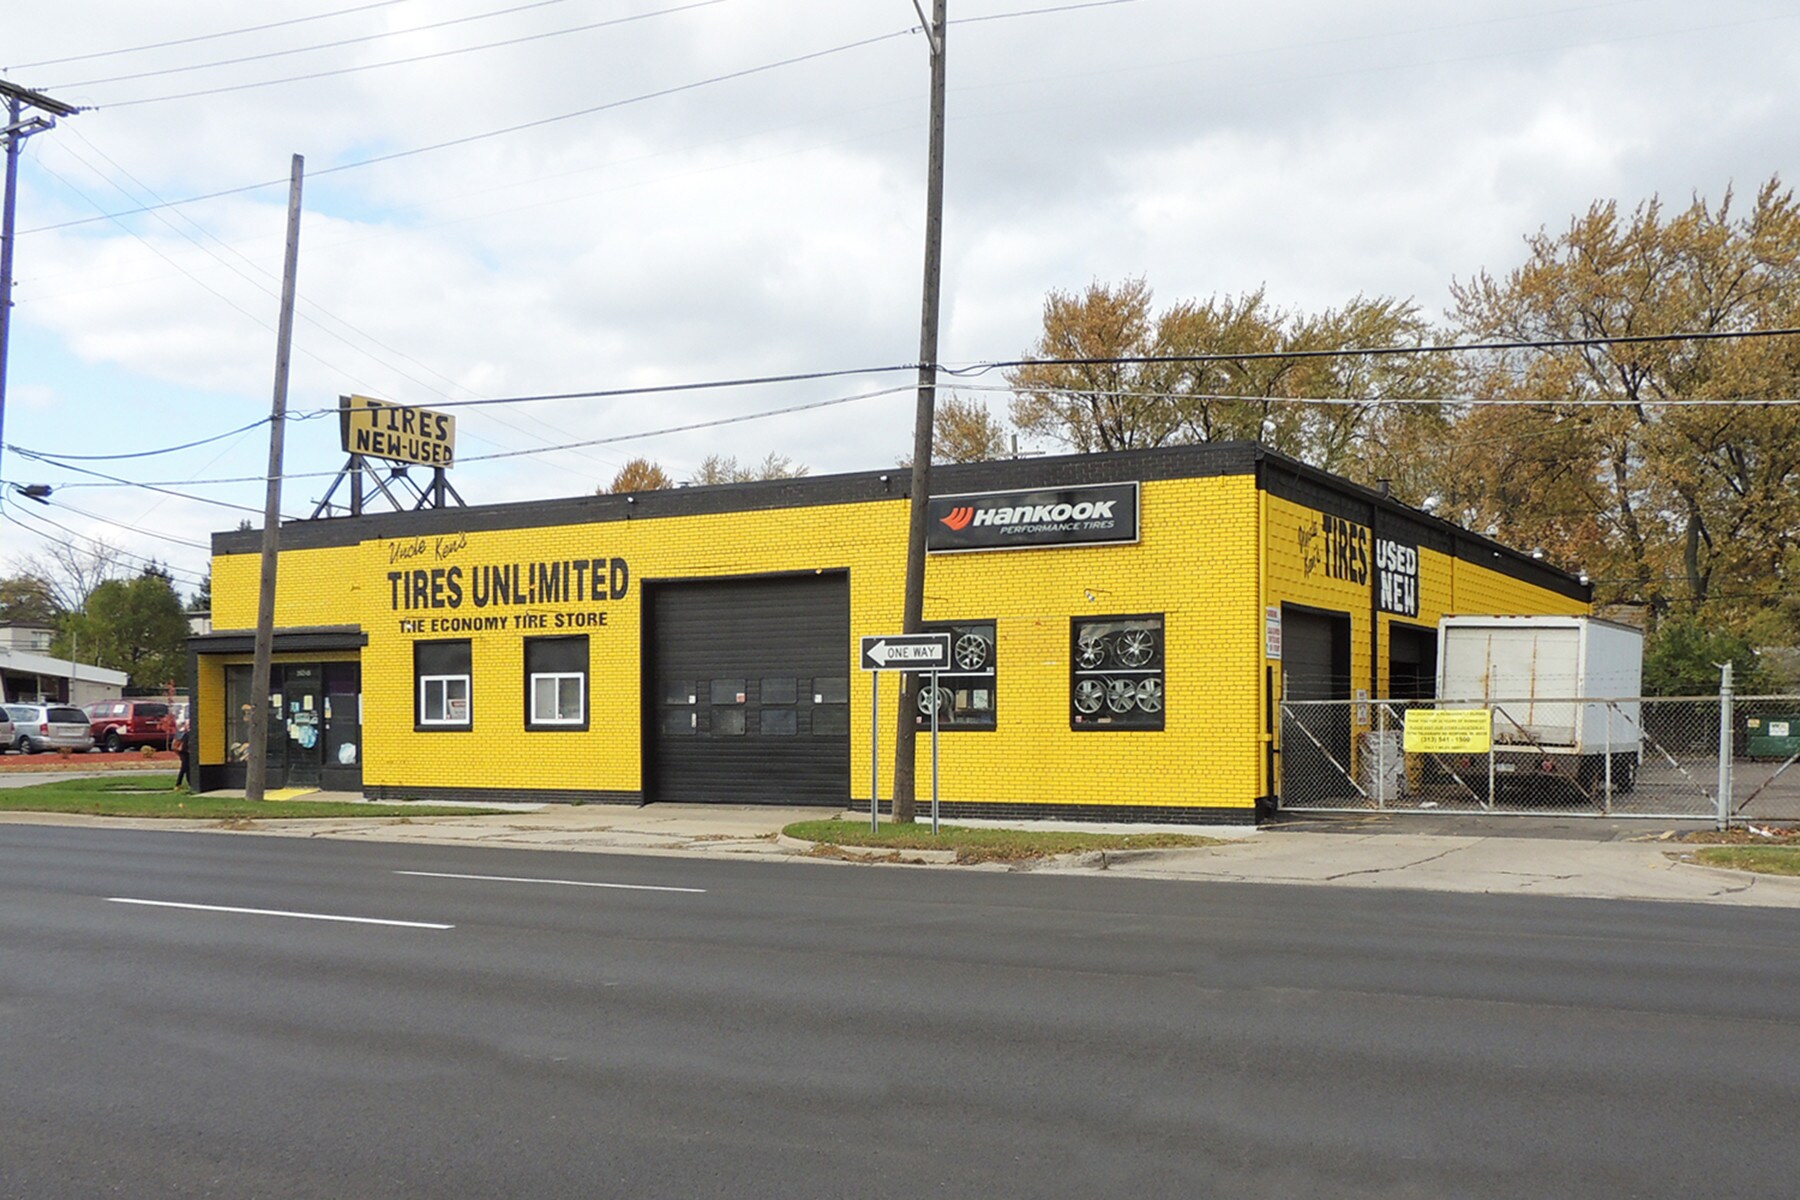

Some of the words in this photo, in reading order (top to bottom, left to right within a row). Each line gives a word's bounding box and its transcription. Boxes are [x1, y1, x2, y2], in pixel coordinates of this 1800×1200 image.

[366, 401, 449, 442] TIRES
[356, 429, 453, 466] NEW-USED
[999, 521, 1080, 535] PERFORMANCE
[1082, 519, 1115, 530] TIRES
[388, 536, 427, 565] Uncle
[1322, 514, 1368, 587] TIRES
[1376, 538, 1417, 577] USED
[387, 565, 463, 610] TIRES
[472, 557, 629, 608] UNLIMITED
[1380, 570, 1415, 615] NEW
[399, 617, 425, 633] THE
[431, 616, 508, 632] ECONOMY
[514, 612, 547, 629] TIRE
[555, 611, 608, 627] STORE
[887, 647, 909, 658] ONE
[913, 646, 936, 658] WAY
